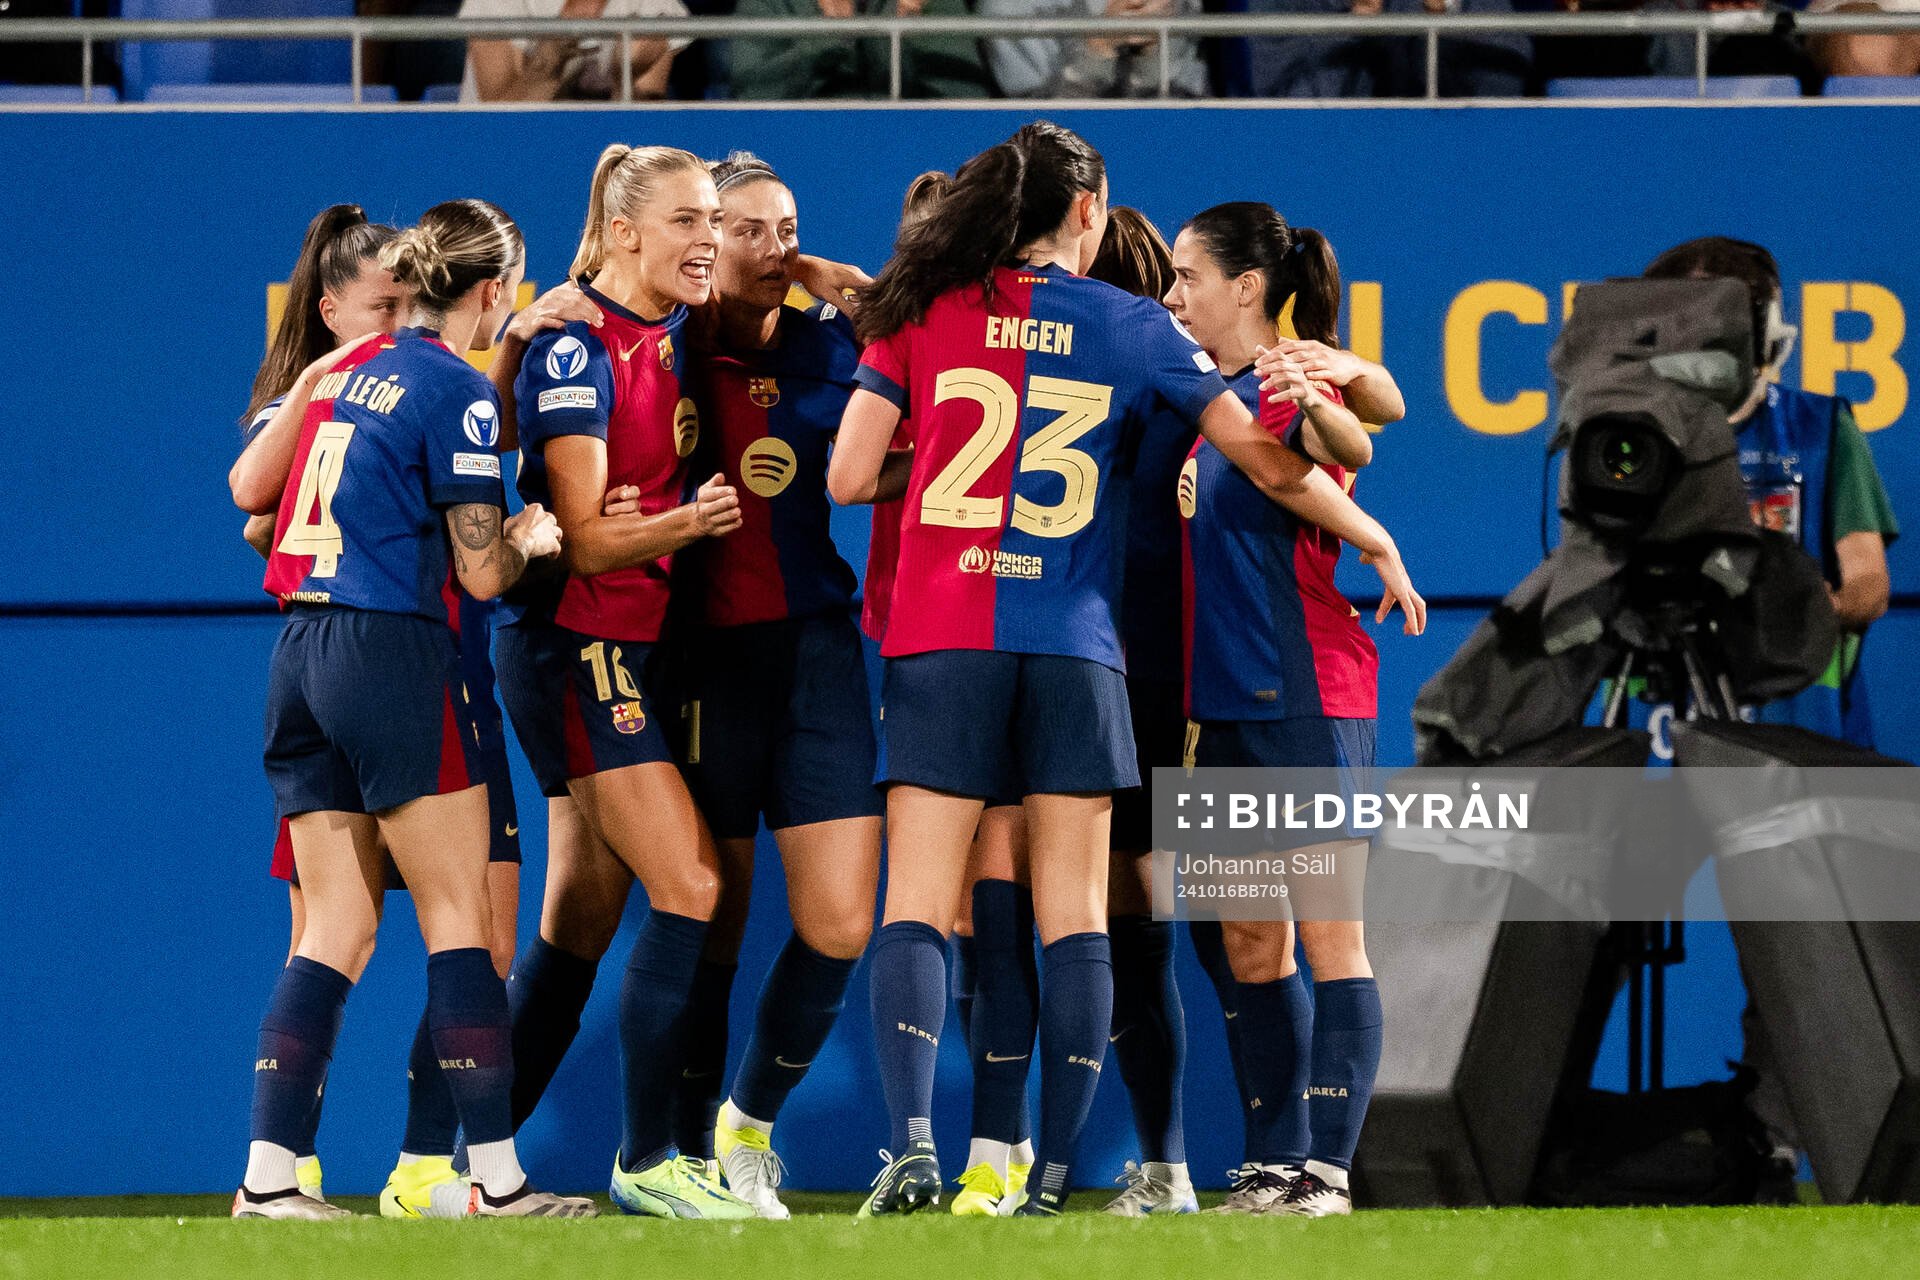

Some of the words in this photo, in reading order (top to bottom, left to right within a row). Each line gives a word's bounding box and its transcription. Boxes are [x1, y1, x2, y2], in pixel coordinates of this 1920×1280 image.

[985, 316, 1074, 355] ENGEN
[345, 374, 406, 415] LEÓN
[540, 392, 595, 405] FOUNDATION
[920, 367, 1114, 538] 23
[277, 421, 356, 578] 4
[991, 562, 1042, 575] ACNUR
[993, 550, 1042, 566] UNHCR
[291, 592, 330, 603] UNHCR
[581, 642, 642, 701] 16
